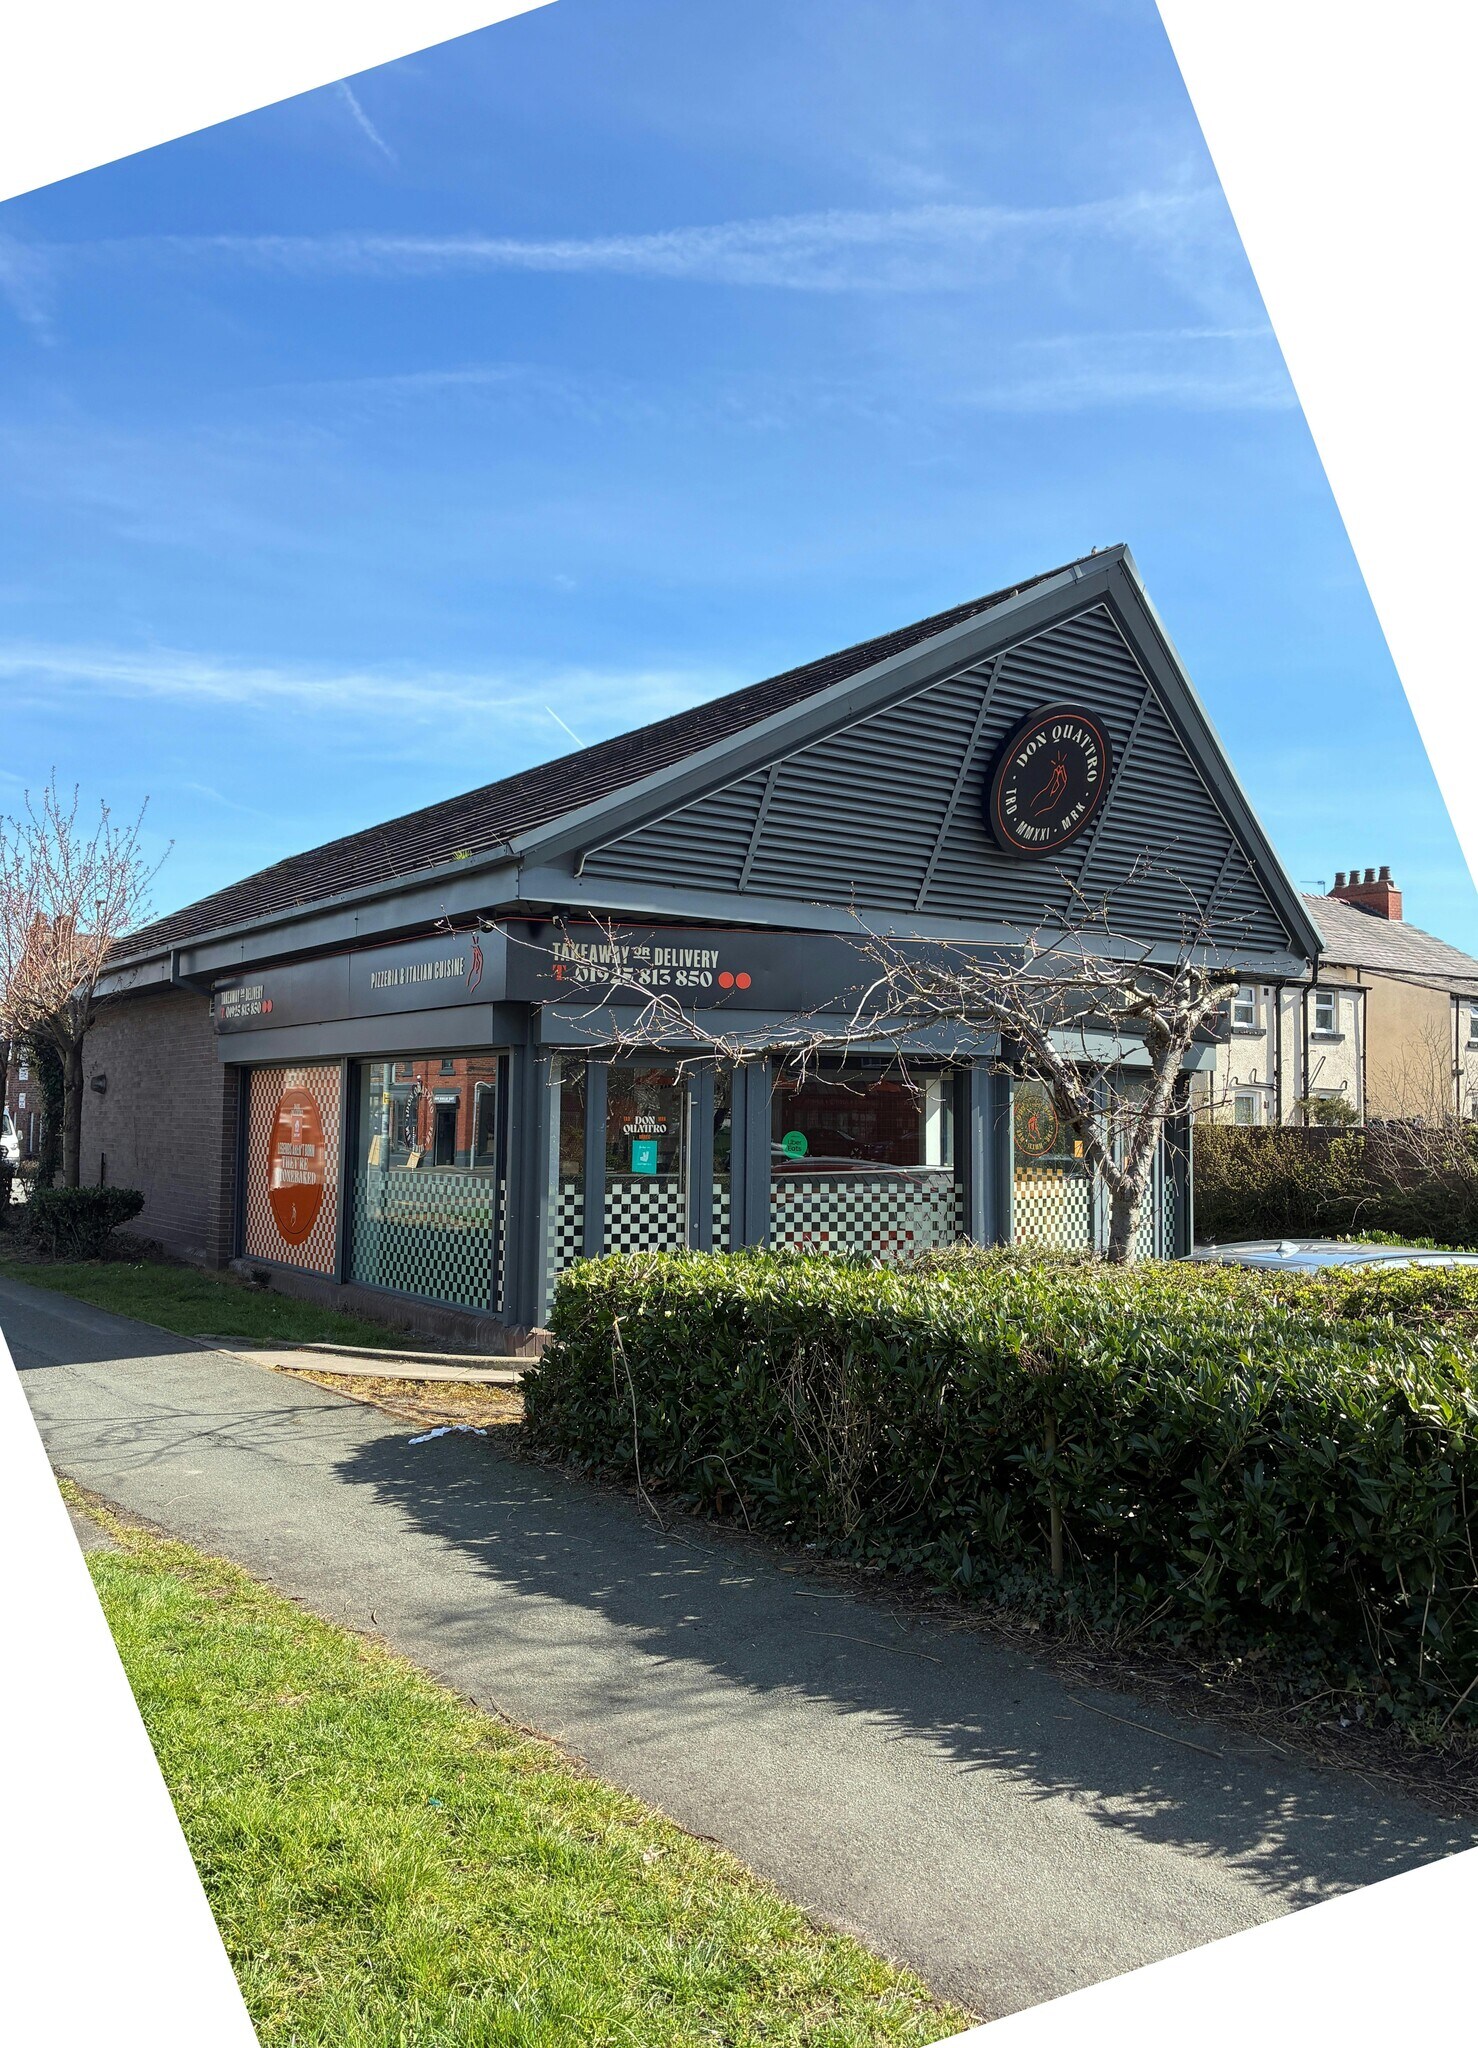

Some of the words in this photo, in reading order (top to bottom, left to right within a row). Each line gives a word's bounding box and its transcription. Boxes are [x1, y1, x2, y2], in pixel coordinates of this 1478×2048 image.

[1016, 731, 1047, 768] DON
[1052, 724, 1098, 783] QUATTRO
[1005, 787, 1018, 815] TRD
[1015, 820, 1050, 842] MMXXI
[1061, 801, 1086, 831] MRK
[553, 942, 630, 965] TAKEAWAY
[633, 946, 650, 960] OR
[654, 947, 719, 969] DELIVERY
[370, 968, 398, 989] PIZZERIA
[399, 967, 406, 985] &
[406, 962, 433, 984] ITALIAN
[434, 957, 464, 979] CUISINE
[574, 965, 635, 985] 01925
[638, 968, 671, 987] 813
[675, 970, 713, 988] 850
[623, 1124, 667, 1135] QUATTRO
[635, 1115, 656, 1125] DON
